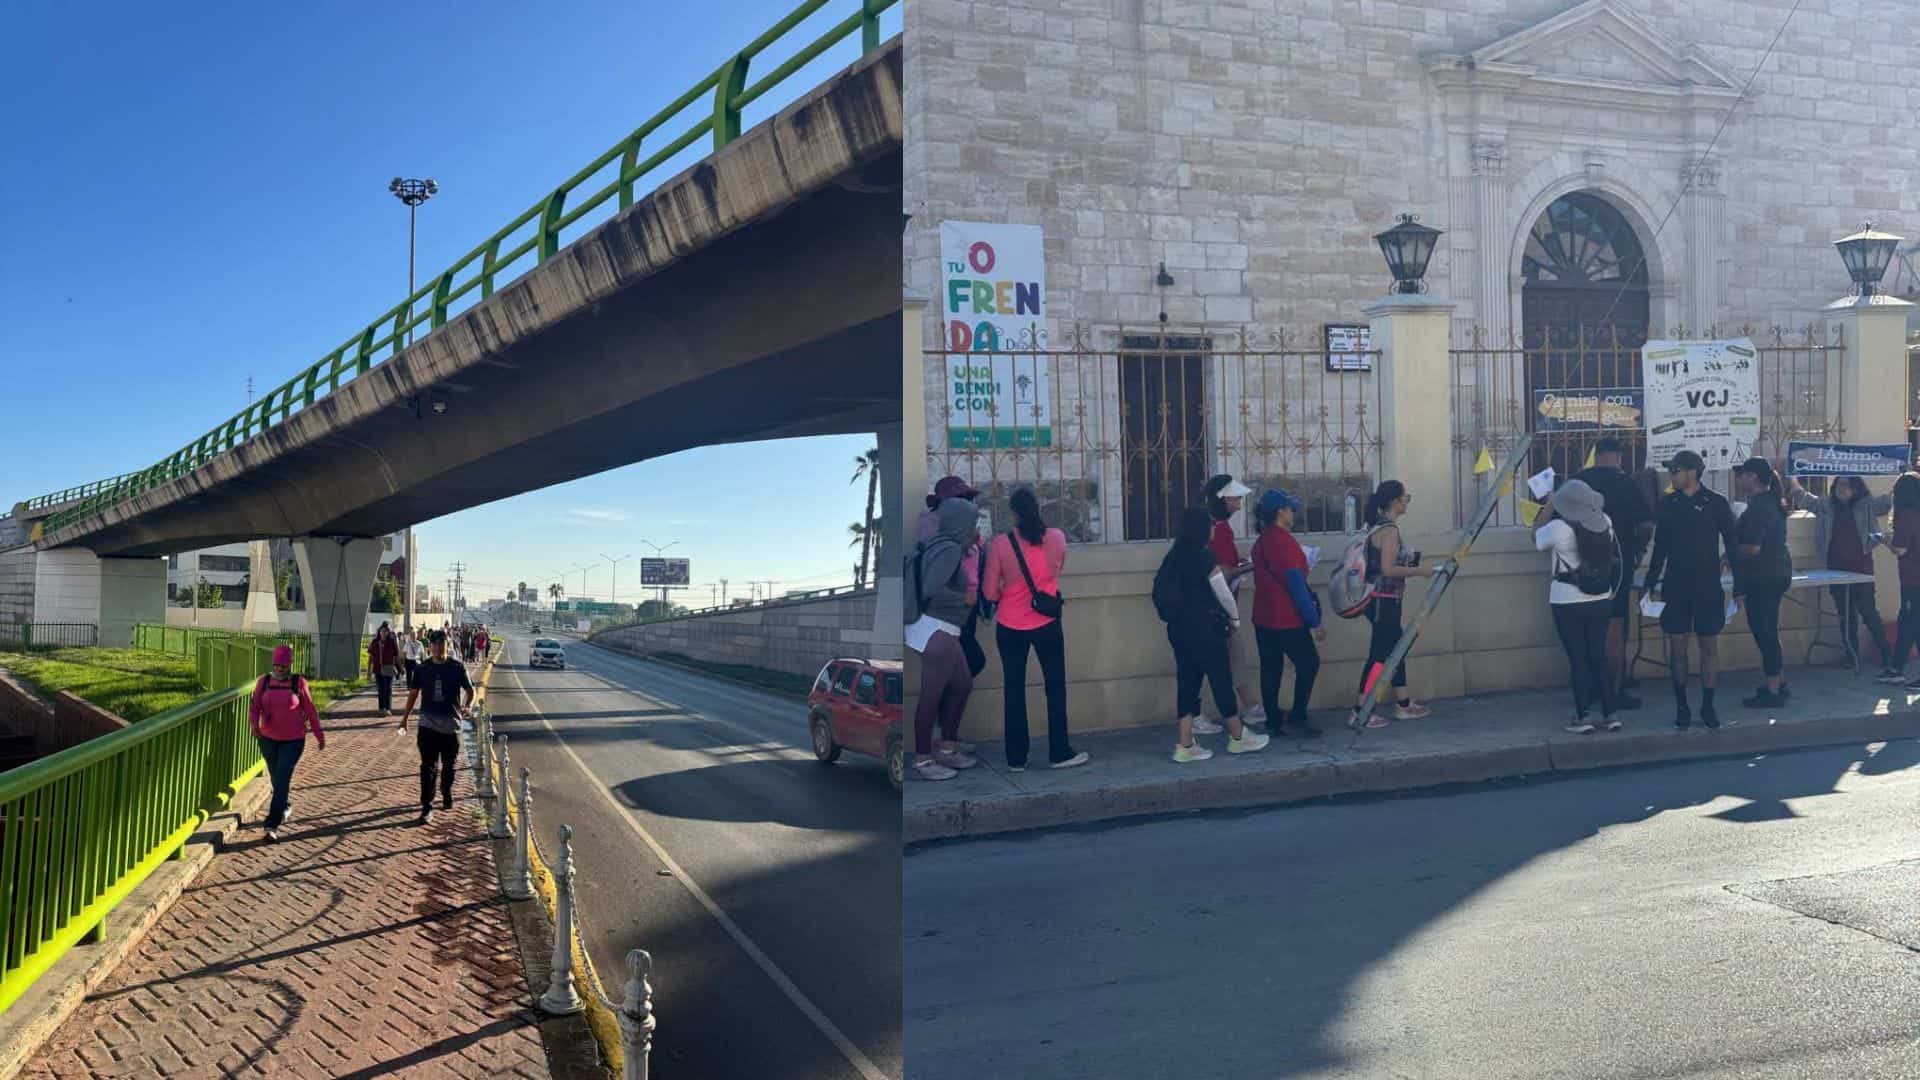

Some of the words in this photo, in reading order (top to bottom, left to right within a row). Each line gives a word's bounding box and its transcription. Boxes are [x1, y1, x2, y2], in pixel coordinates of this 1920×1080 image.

[947, 262, 966, 274] TU
[968, 241, 996, 275] O
[948, 279, 1041, 316] FREN
[950, 319, 1000, 353] DA
[954, 365, 991, 380] UNA
[954, 382, 1001, 396] BENDI
[1686, 389, 1729, 408] VCJ
[1543, 392, 1599, 408] Camina
[1605, 395, 1633, 406] con
